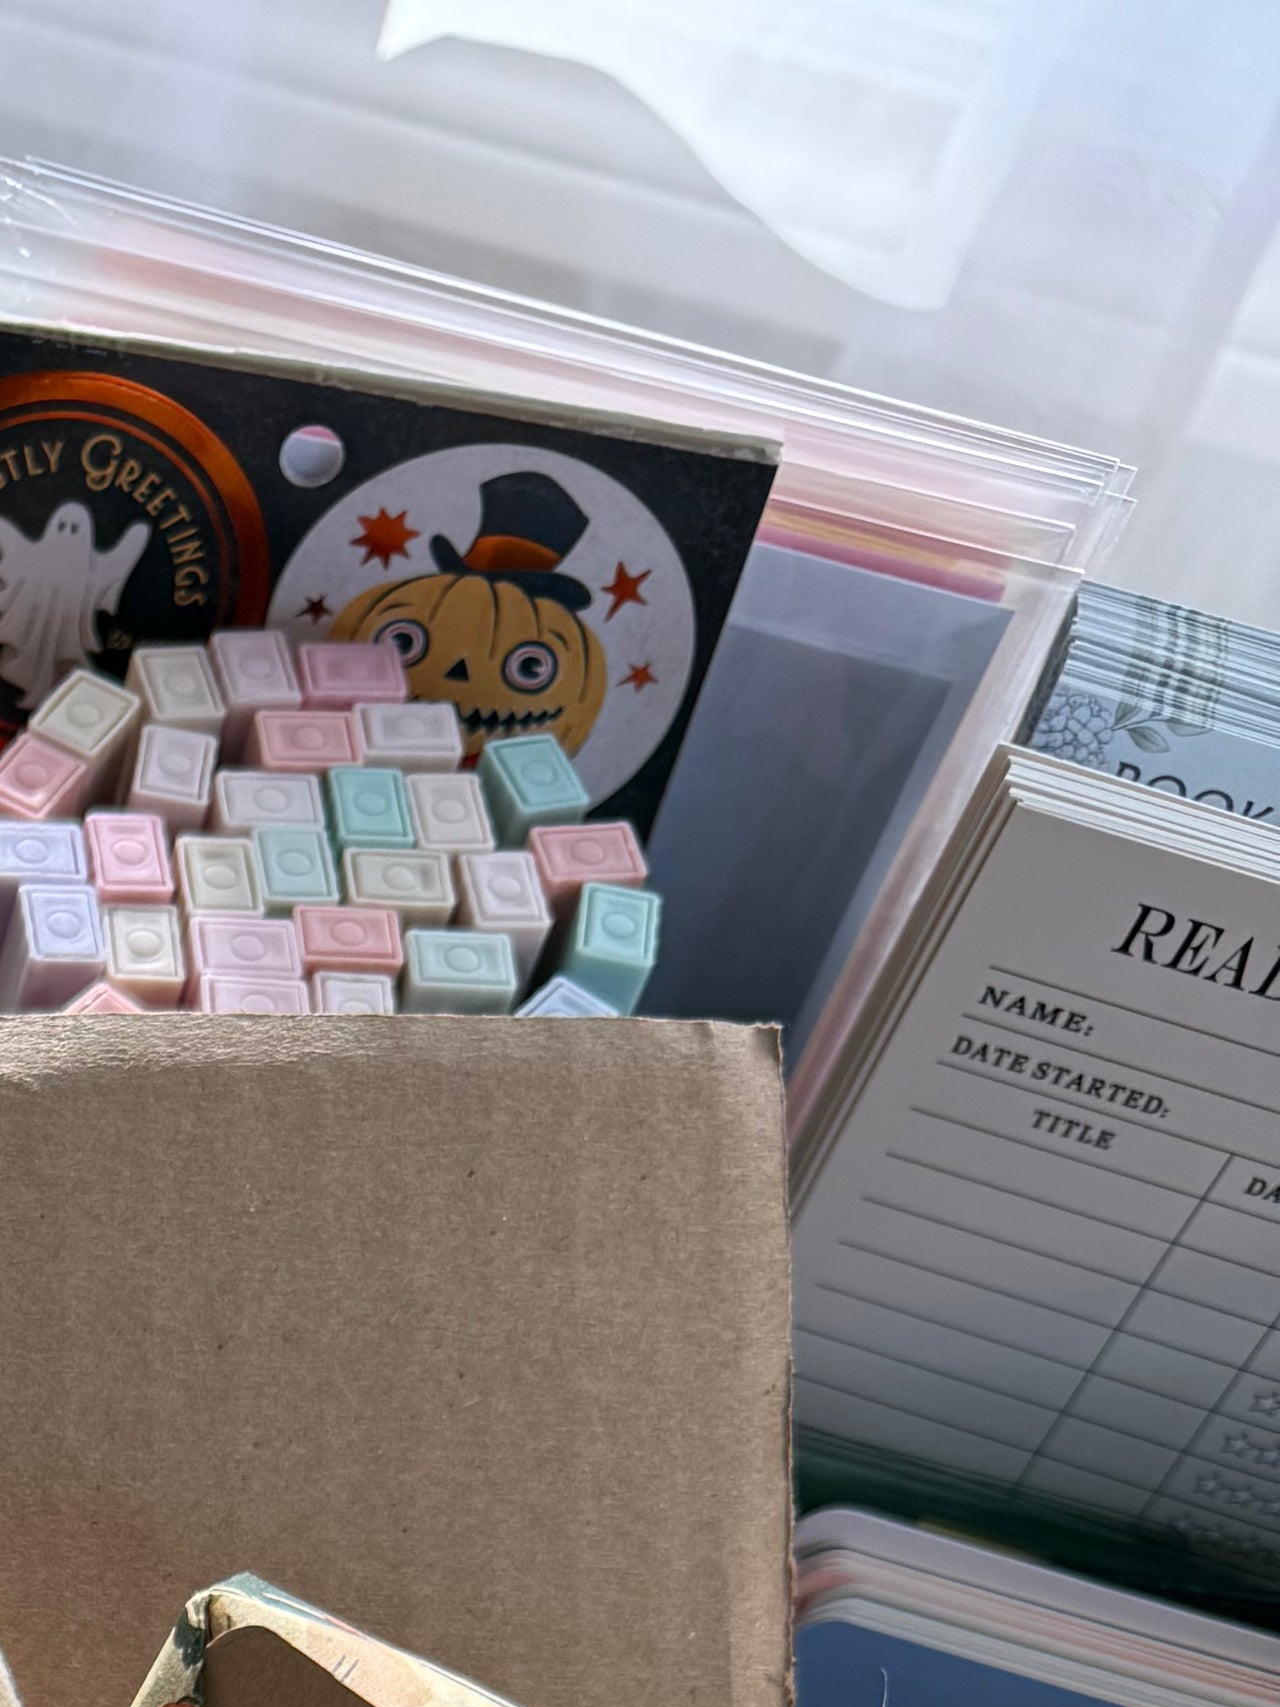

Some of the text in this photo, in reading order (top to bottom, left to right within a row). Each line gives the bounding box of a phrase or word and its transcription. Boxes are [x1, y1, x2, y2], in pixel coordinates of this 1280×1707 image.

[80, 434, 208, 606] GREETINGS
[979, 986, 1095, 1037] NAME:
[951, 1035, 1171, 1118] DATE STARTED:
[1032, 1110, 1117, 1151] TITLE
